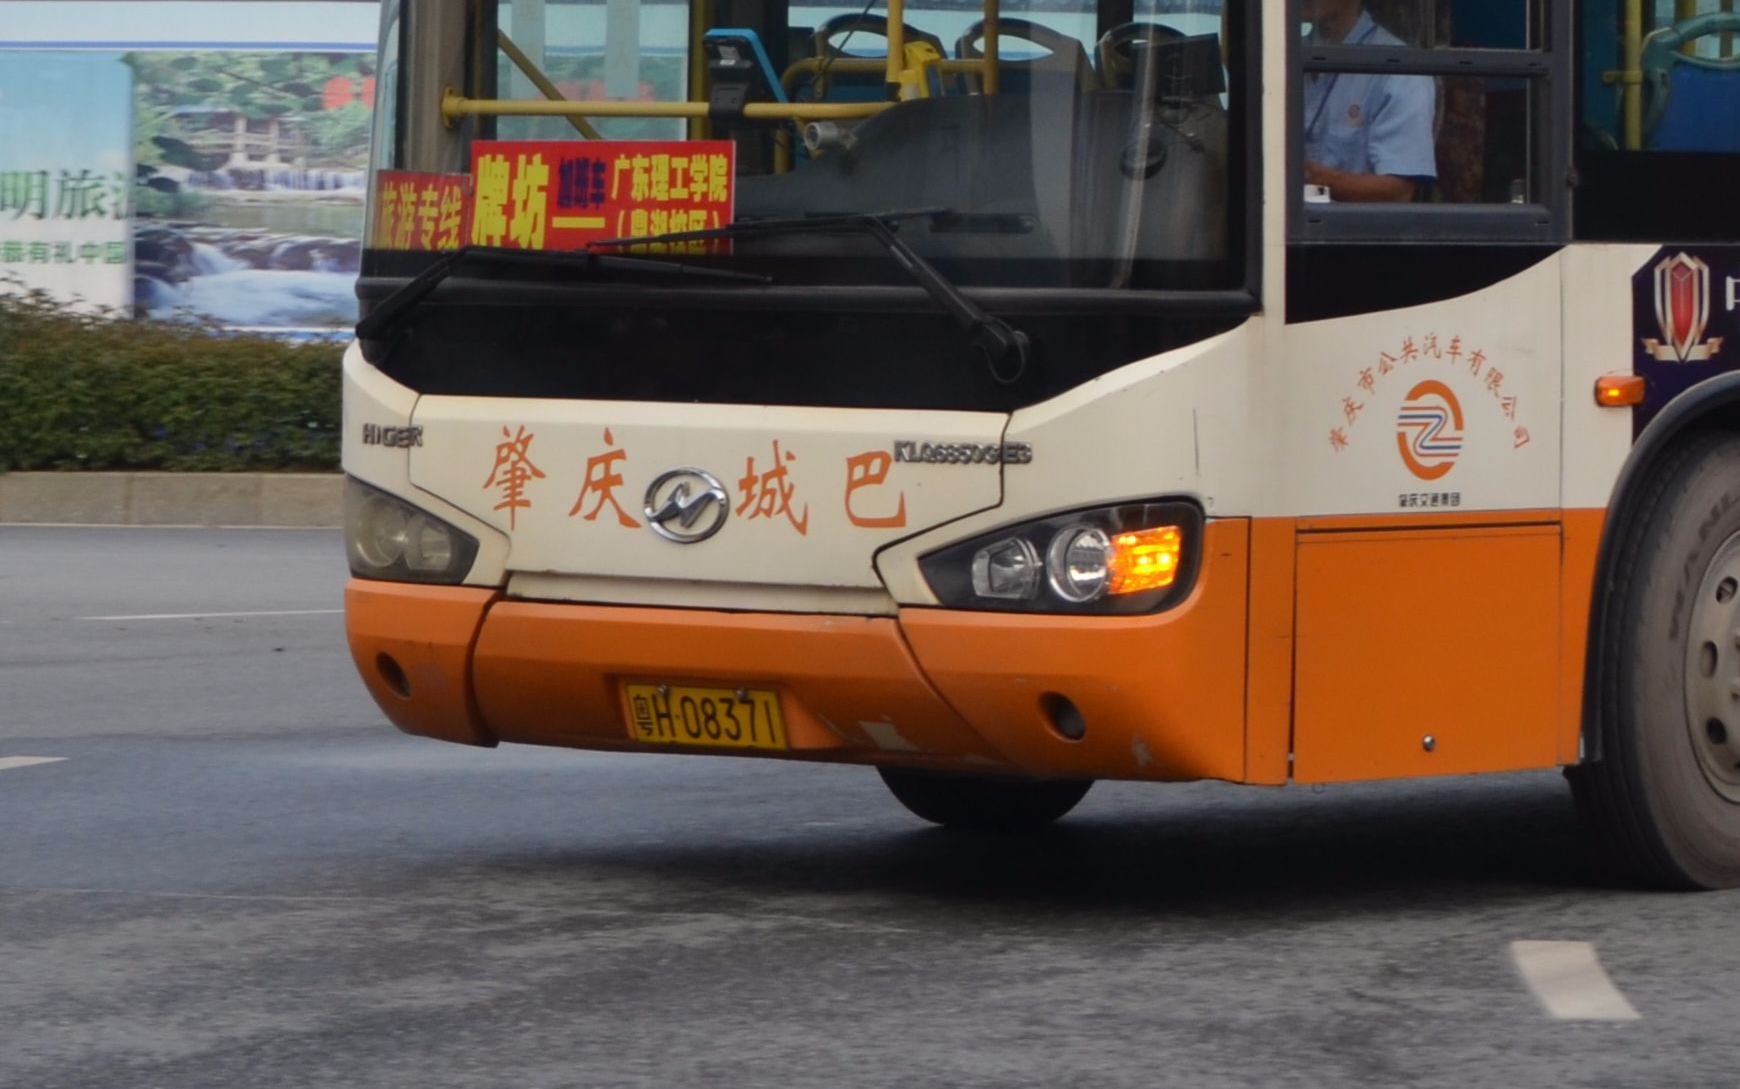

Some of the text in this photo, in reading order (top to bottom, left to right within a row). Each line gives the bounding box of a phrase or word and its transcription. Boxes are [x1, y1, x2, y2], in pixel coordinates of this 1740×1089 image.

[1, 168, 128, 220] 明旅
[379, 182, 462, 250] 旅游专线
[471, 153, 549, 250] 牌坊
[612, 153, 728, 204] 广东理工学院
[363, 423, 424, 448] HIGER
